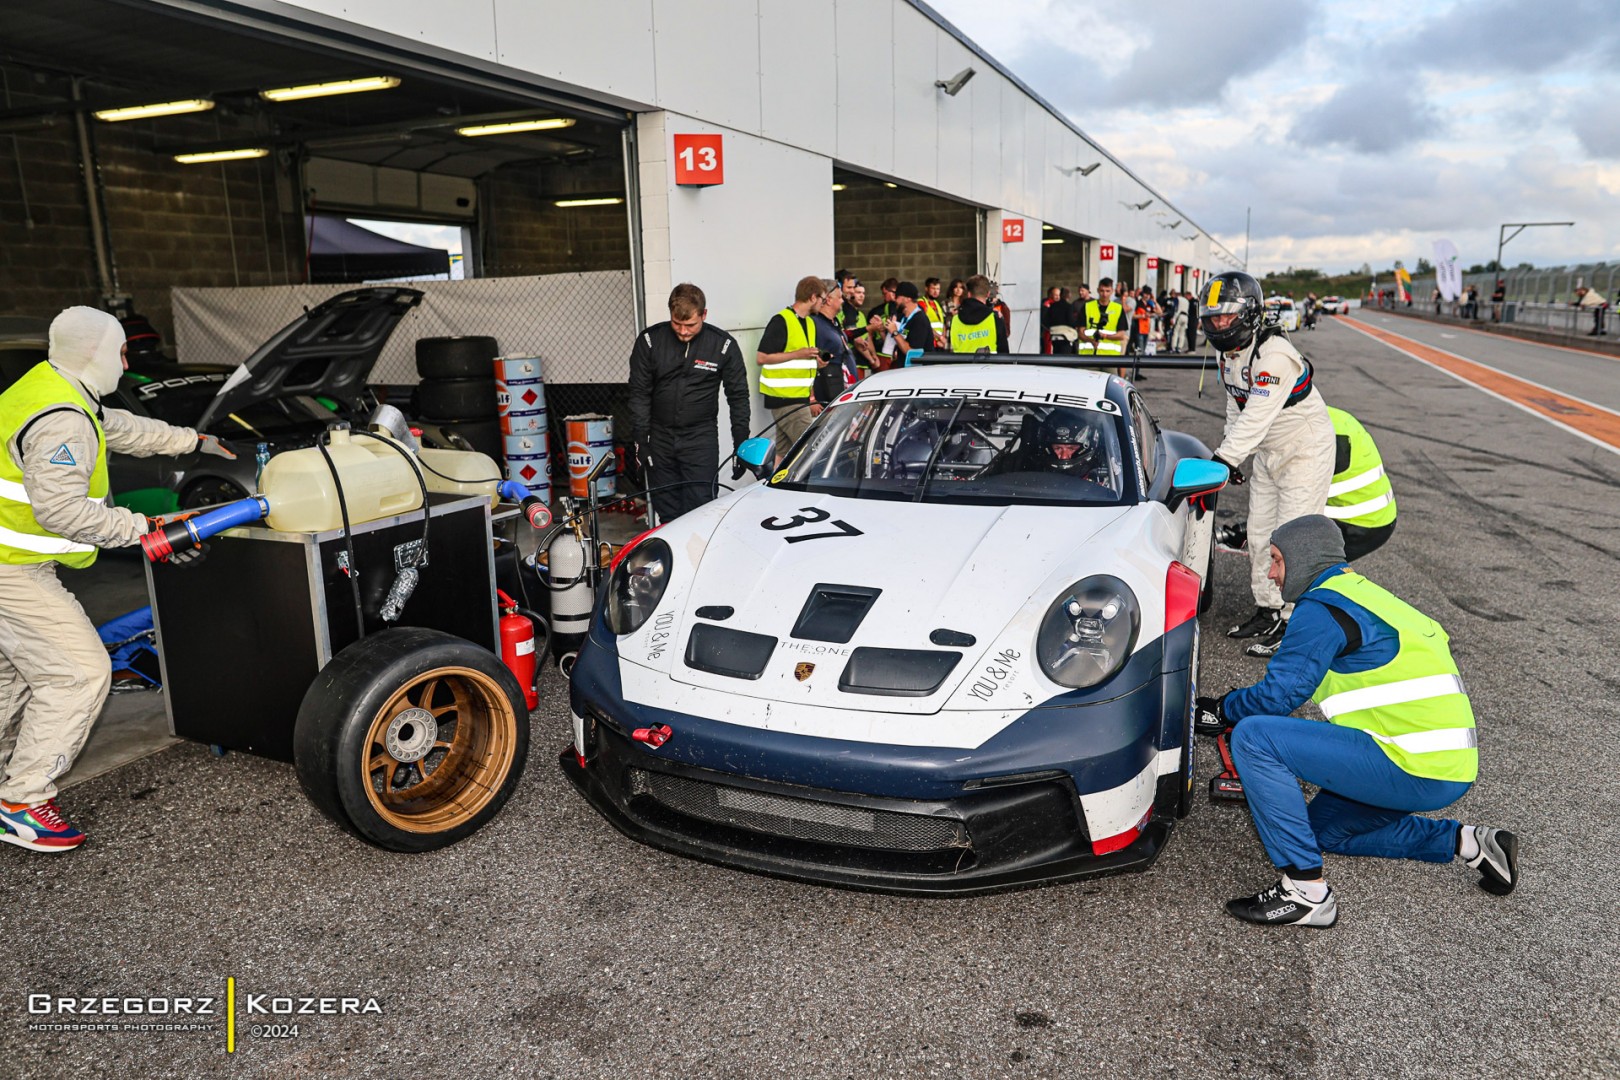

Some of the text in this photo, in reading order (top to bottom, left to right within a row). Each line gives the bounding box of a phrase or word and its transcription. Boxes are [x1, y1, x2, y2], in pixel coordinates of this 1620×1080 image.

[679, 147, 717, 171] 13
[1004, 225, 1022, 237] 12
[1102, 248, 1113, 257] 11
[957, 329, 989, 341] TV CREW
[139, 374, 231, 395] PORS
[854, 388, 1090, 407] PORSCHE
[760, 507, 865, 544] 37
[647, 610, 675, 661] YOU & Me
[781, 641, 852, 657] THE ONE
[967, 648, 1021, 702] YOU & Me
[1266, 903, 1297, 920] sparco
